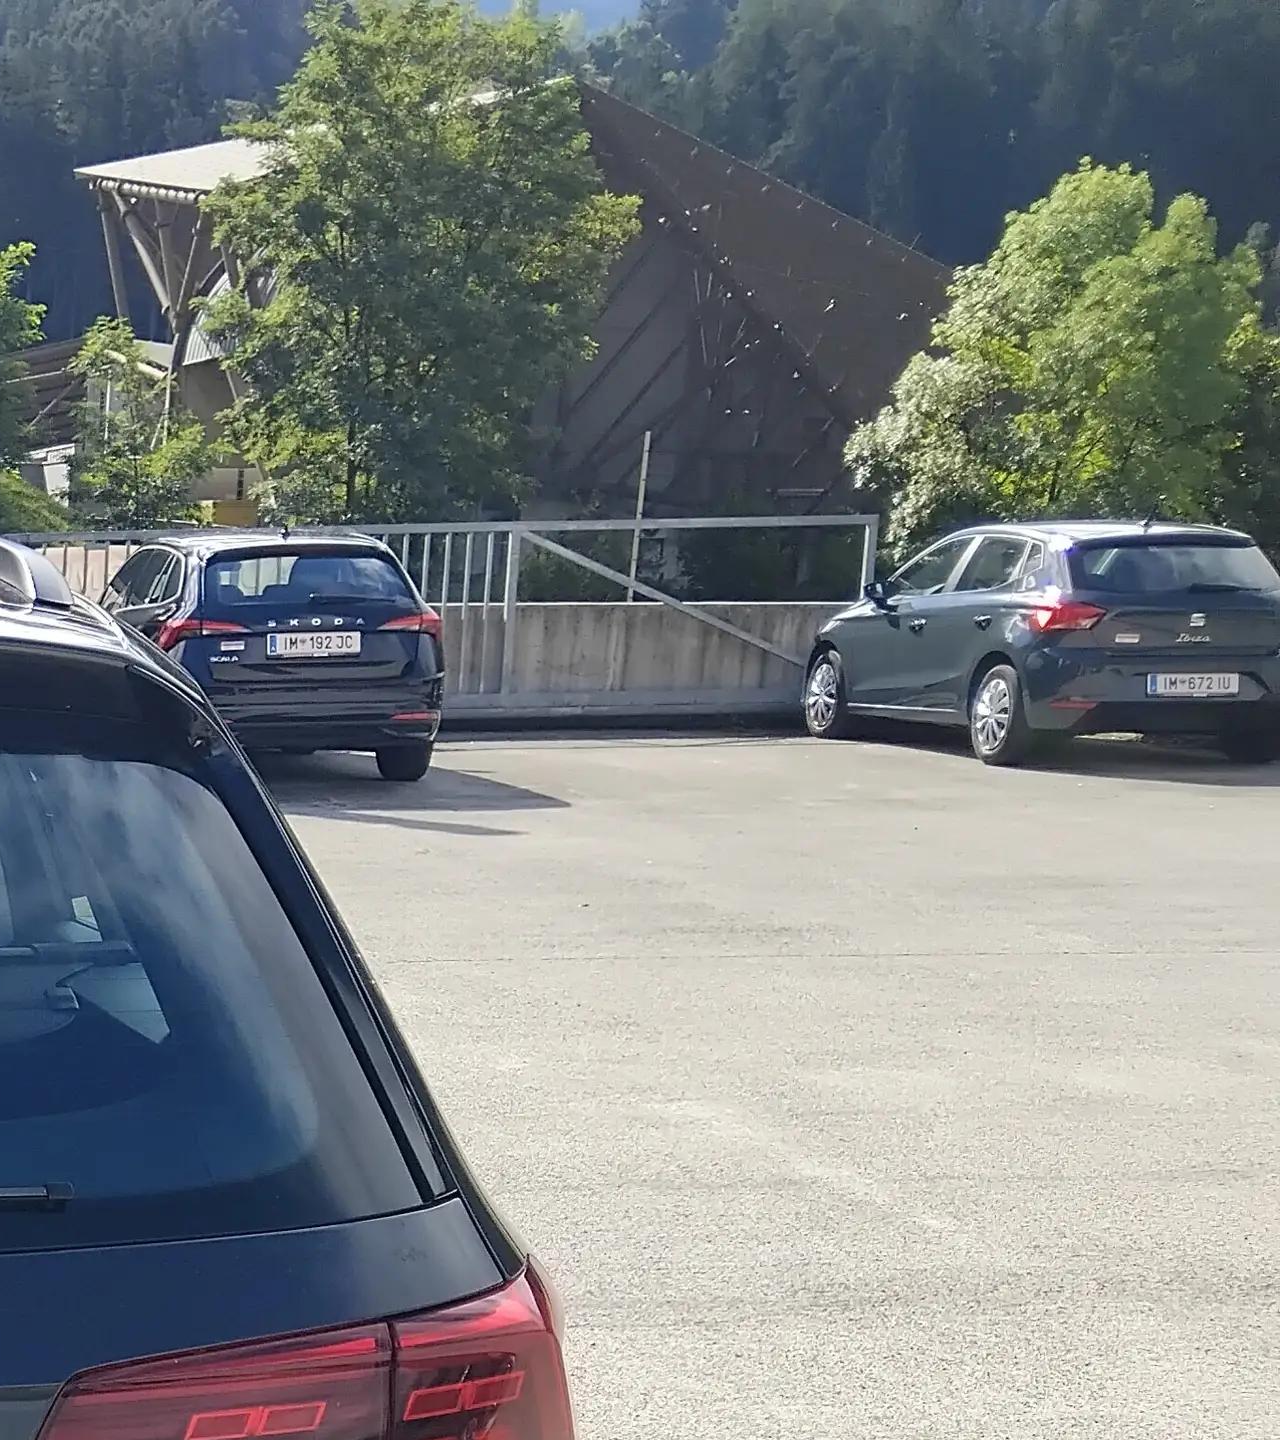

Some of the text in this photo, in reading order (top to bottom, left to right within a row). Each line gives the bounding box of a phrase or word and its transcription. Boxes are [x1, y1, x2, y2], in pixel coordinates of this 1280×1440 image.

[267, 617, 366, 627] SKODA
[284, 636, 298, 650] IM
[309, 635, 333, 650] 192
[335, 635, 353, 649] JC
[1175, 632, 1212, 643] Ibiza
[1163, 677, 1178, 690] IM
[1188, 677, 1214, 690] 672
[1217, 676, 1231, 690] IU
